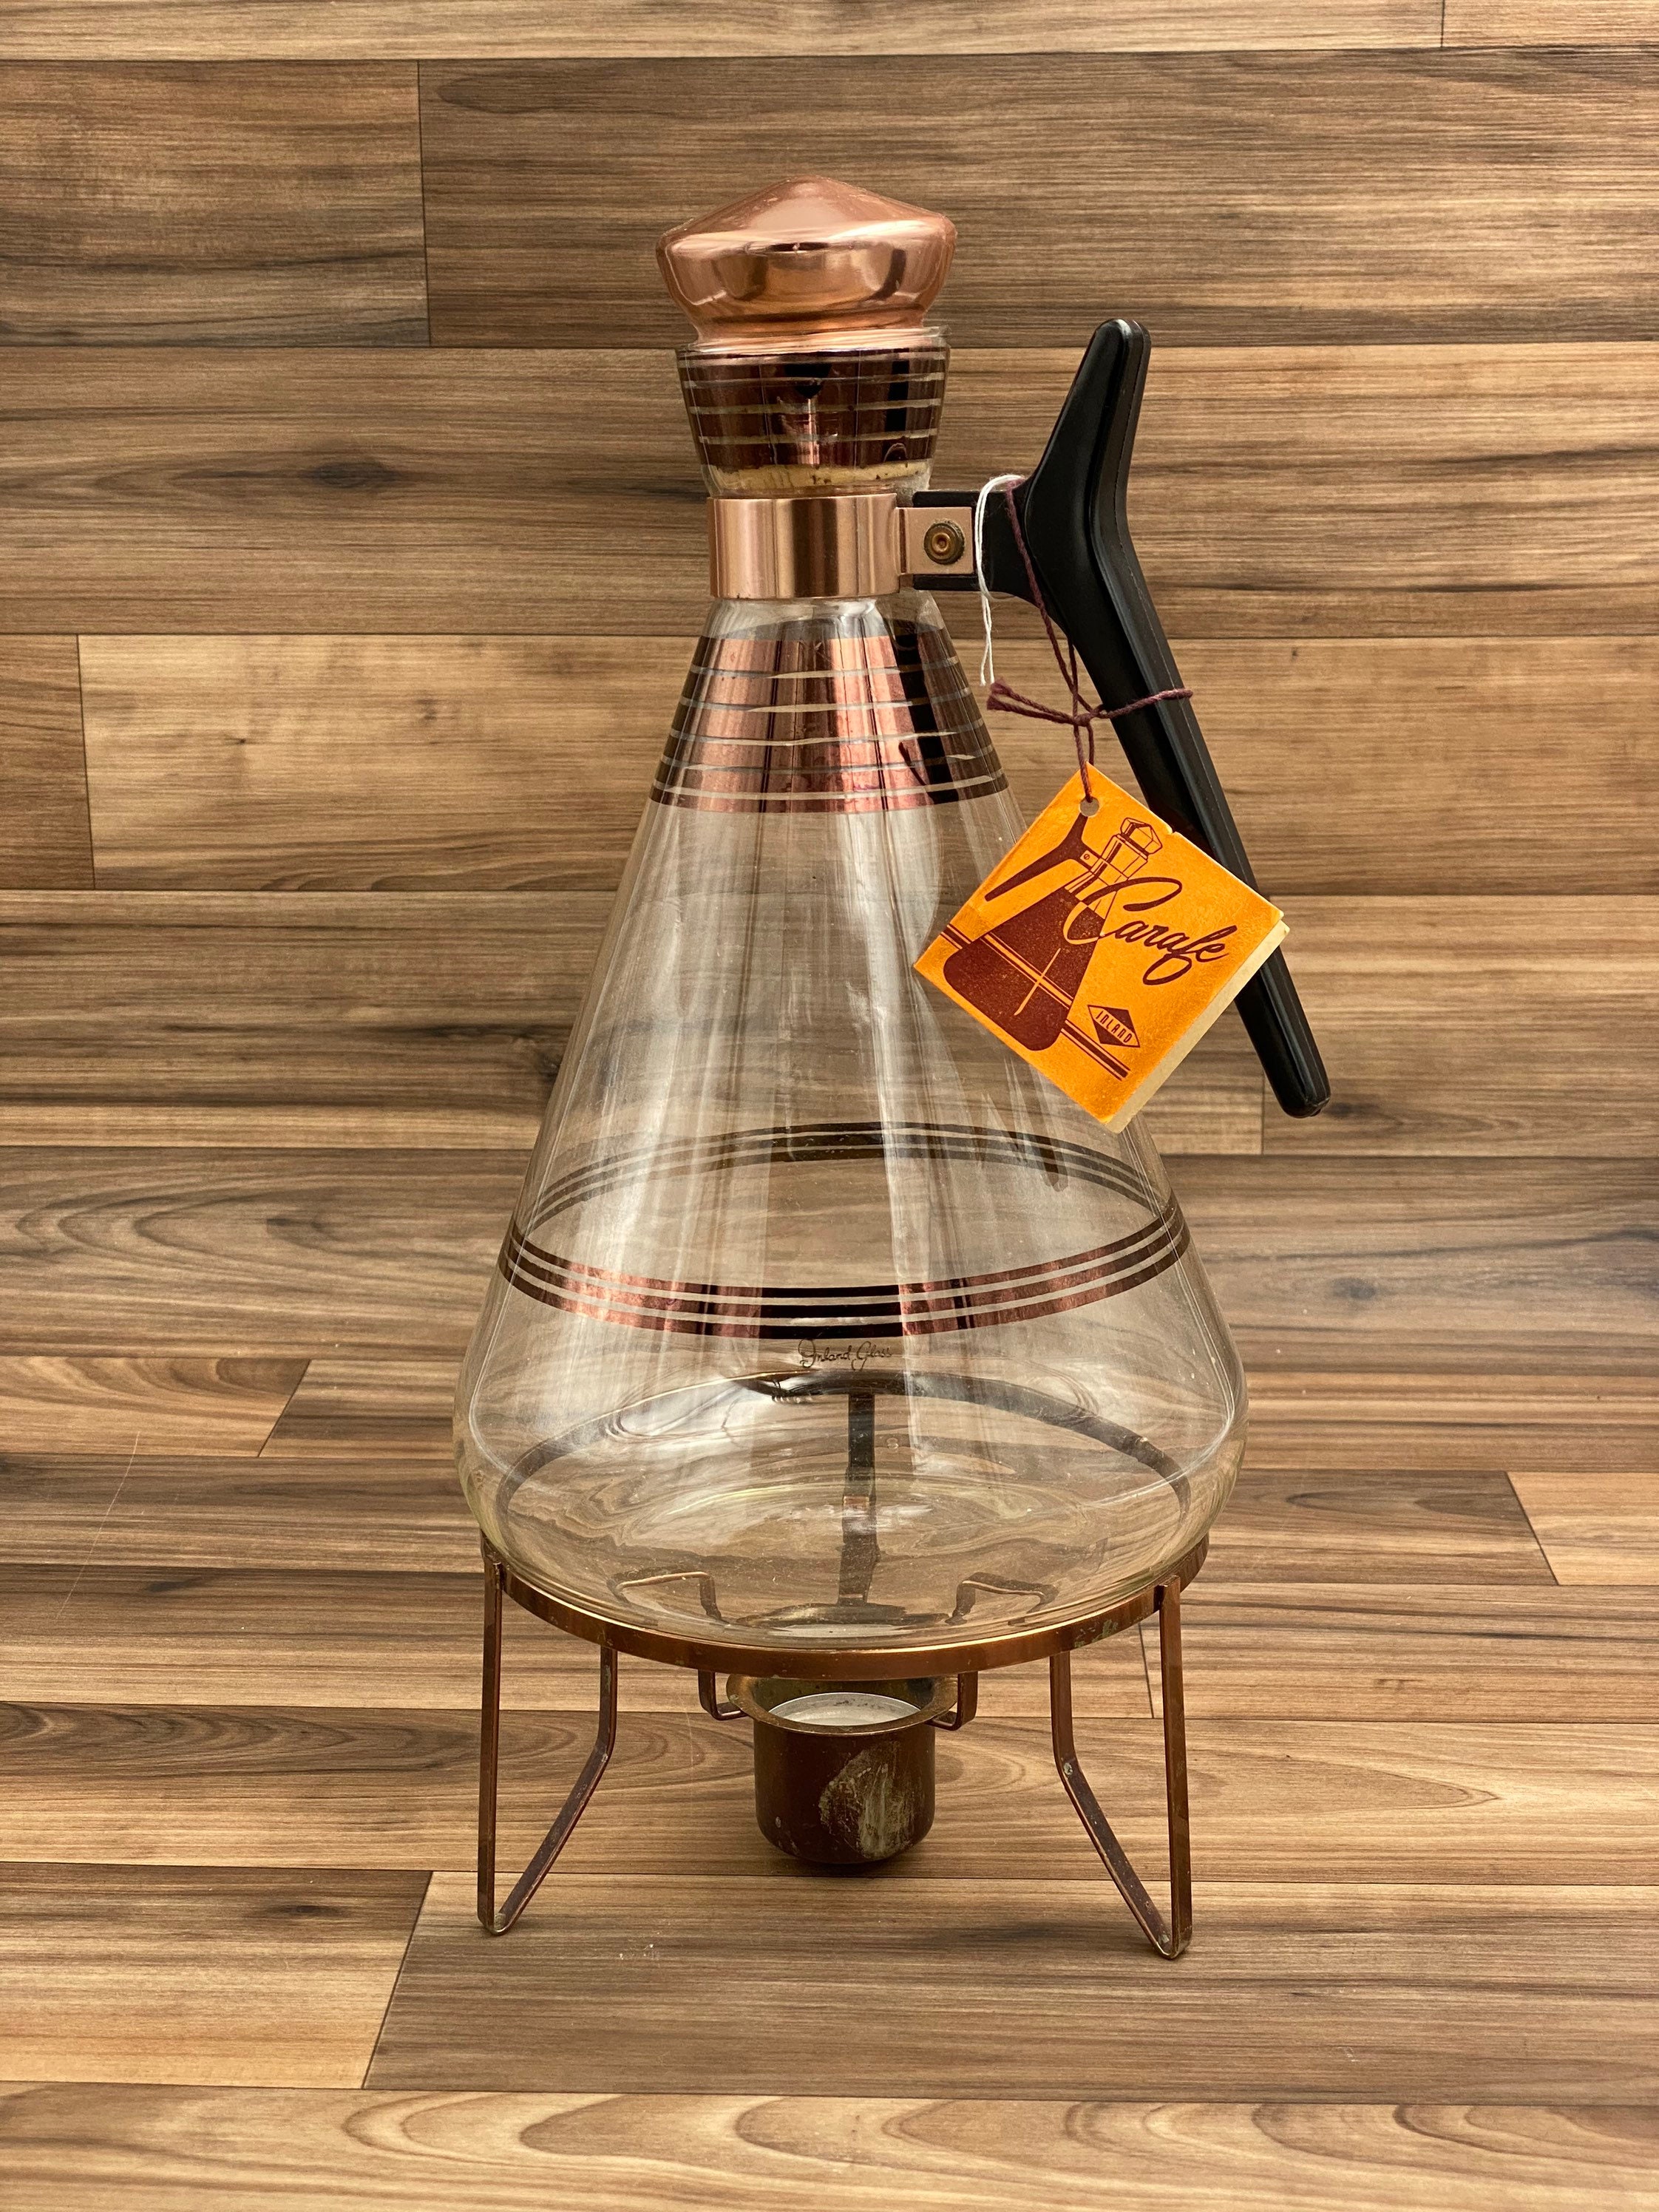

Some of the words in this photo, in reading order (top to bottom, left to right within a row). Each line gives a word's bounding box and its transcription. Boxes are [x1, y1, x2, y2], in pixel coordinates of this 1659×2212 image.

[1063, 877, 1238, 986] Carafe
[1095, 1010, 1133, 1043] INLAND
[798, 1338, 852, 1368] Inland
[851, 1340, 892, 1371] Glass
